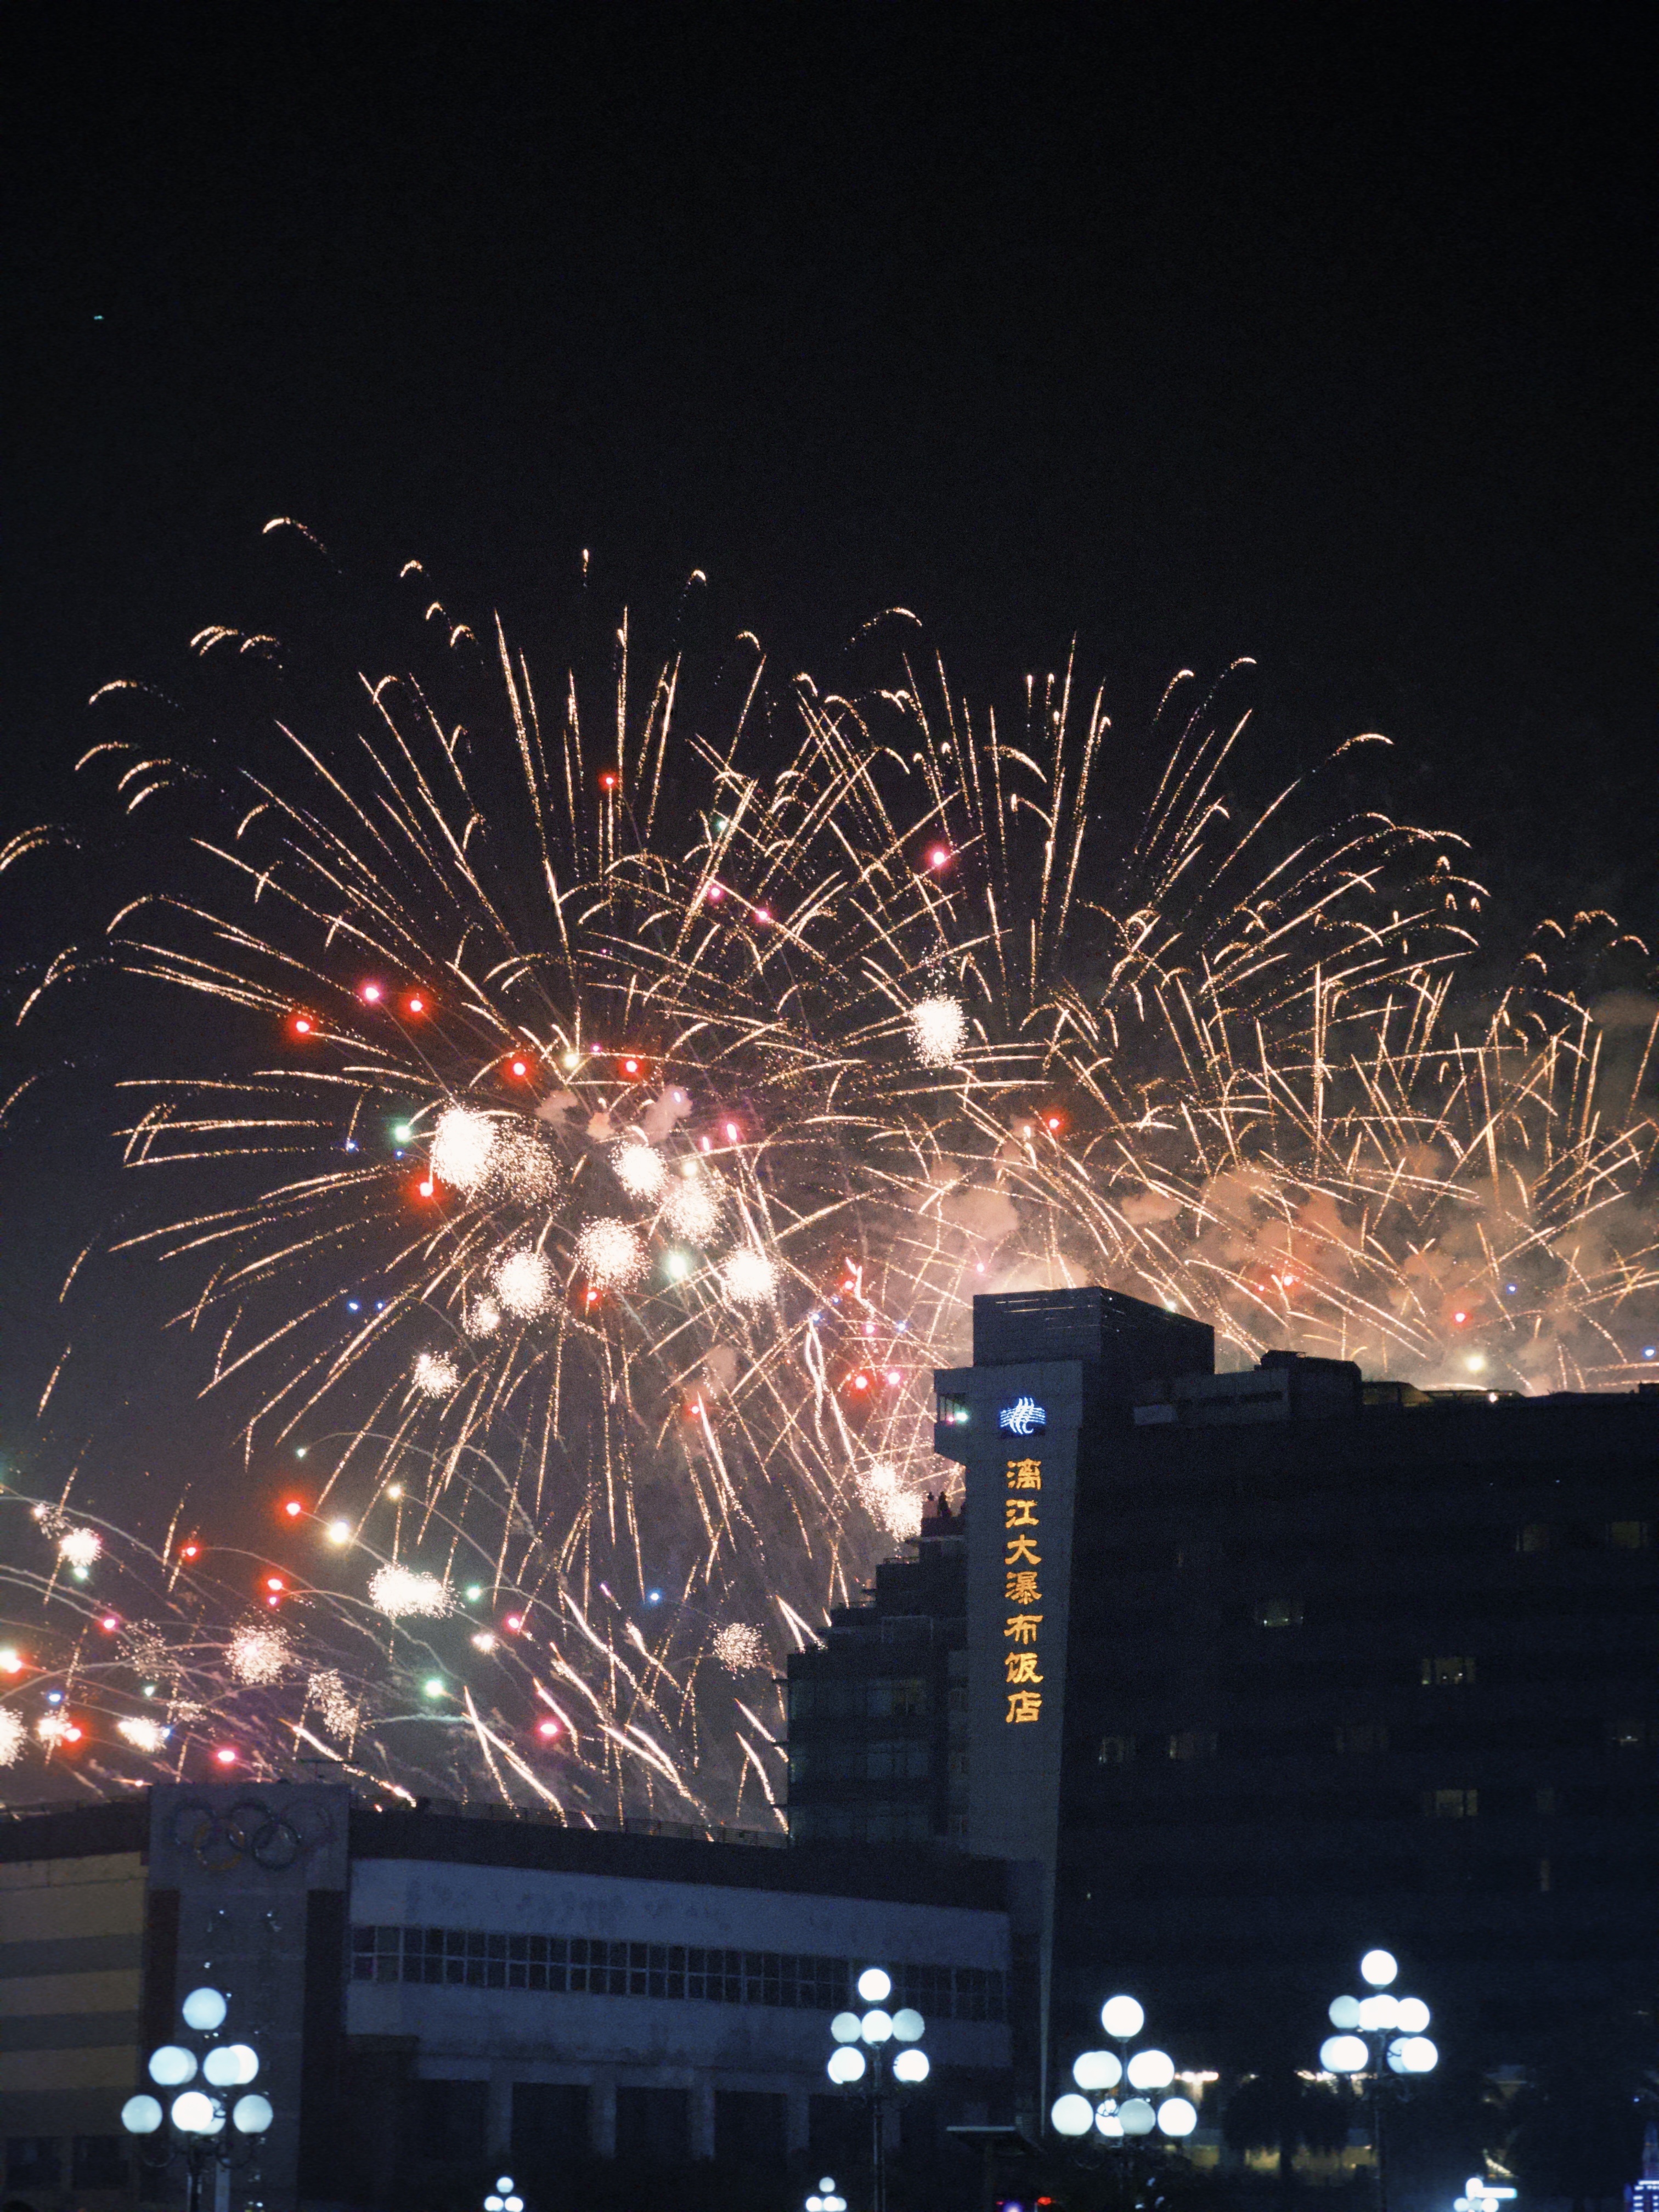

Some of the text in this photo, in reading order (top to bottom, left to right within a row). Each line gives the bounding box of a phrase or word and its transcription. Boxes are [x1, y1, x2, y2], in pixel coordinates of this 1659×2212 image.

[1004, 1458, 1043, 1723] 漓江大瀑布饭店
